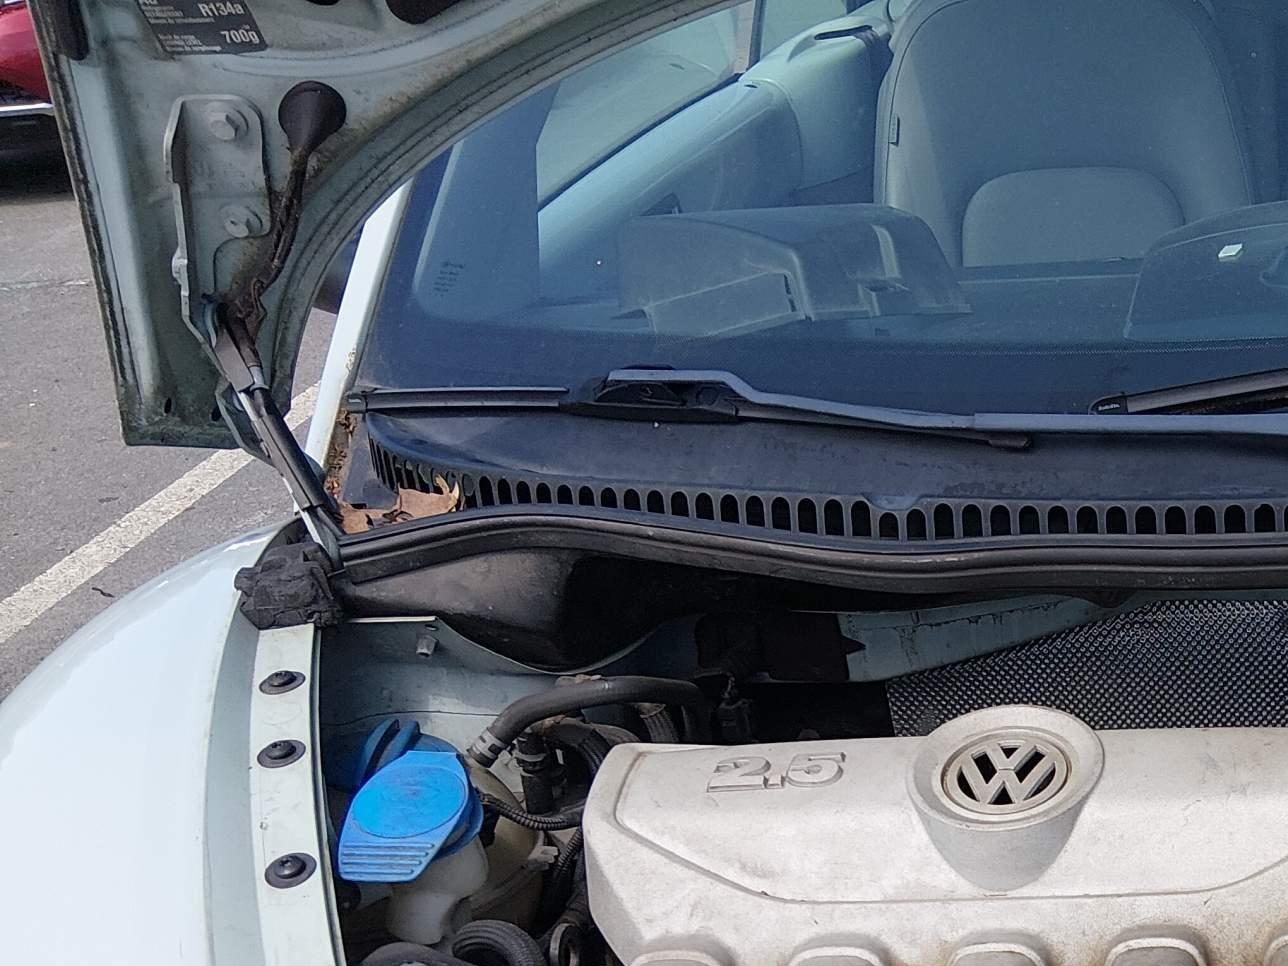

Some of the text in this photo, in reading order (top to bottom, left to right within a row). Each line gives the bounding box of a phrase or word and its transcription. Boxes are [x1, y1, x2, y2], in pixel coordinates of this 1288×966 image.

[198, 1, 245, 17] R134a
[220, 29, 260, 45] 700g
[706, 752, 847, 793] 2.5
